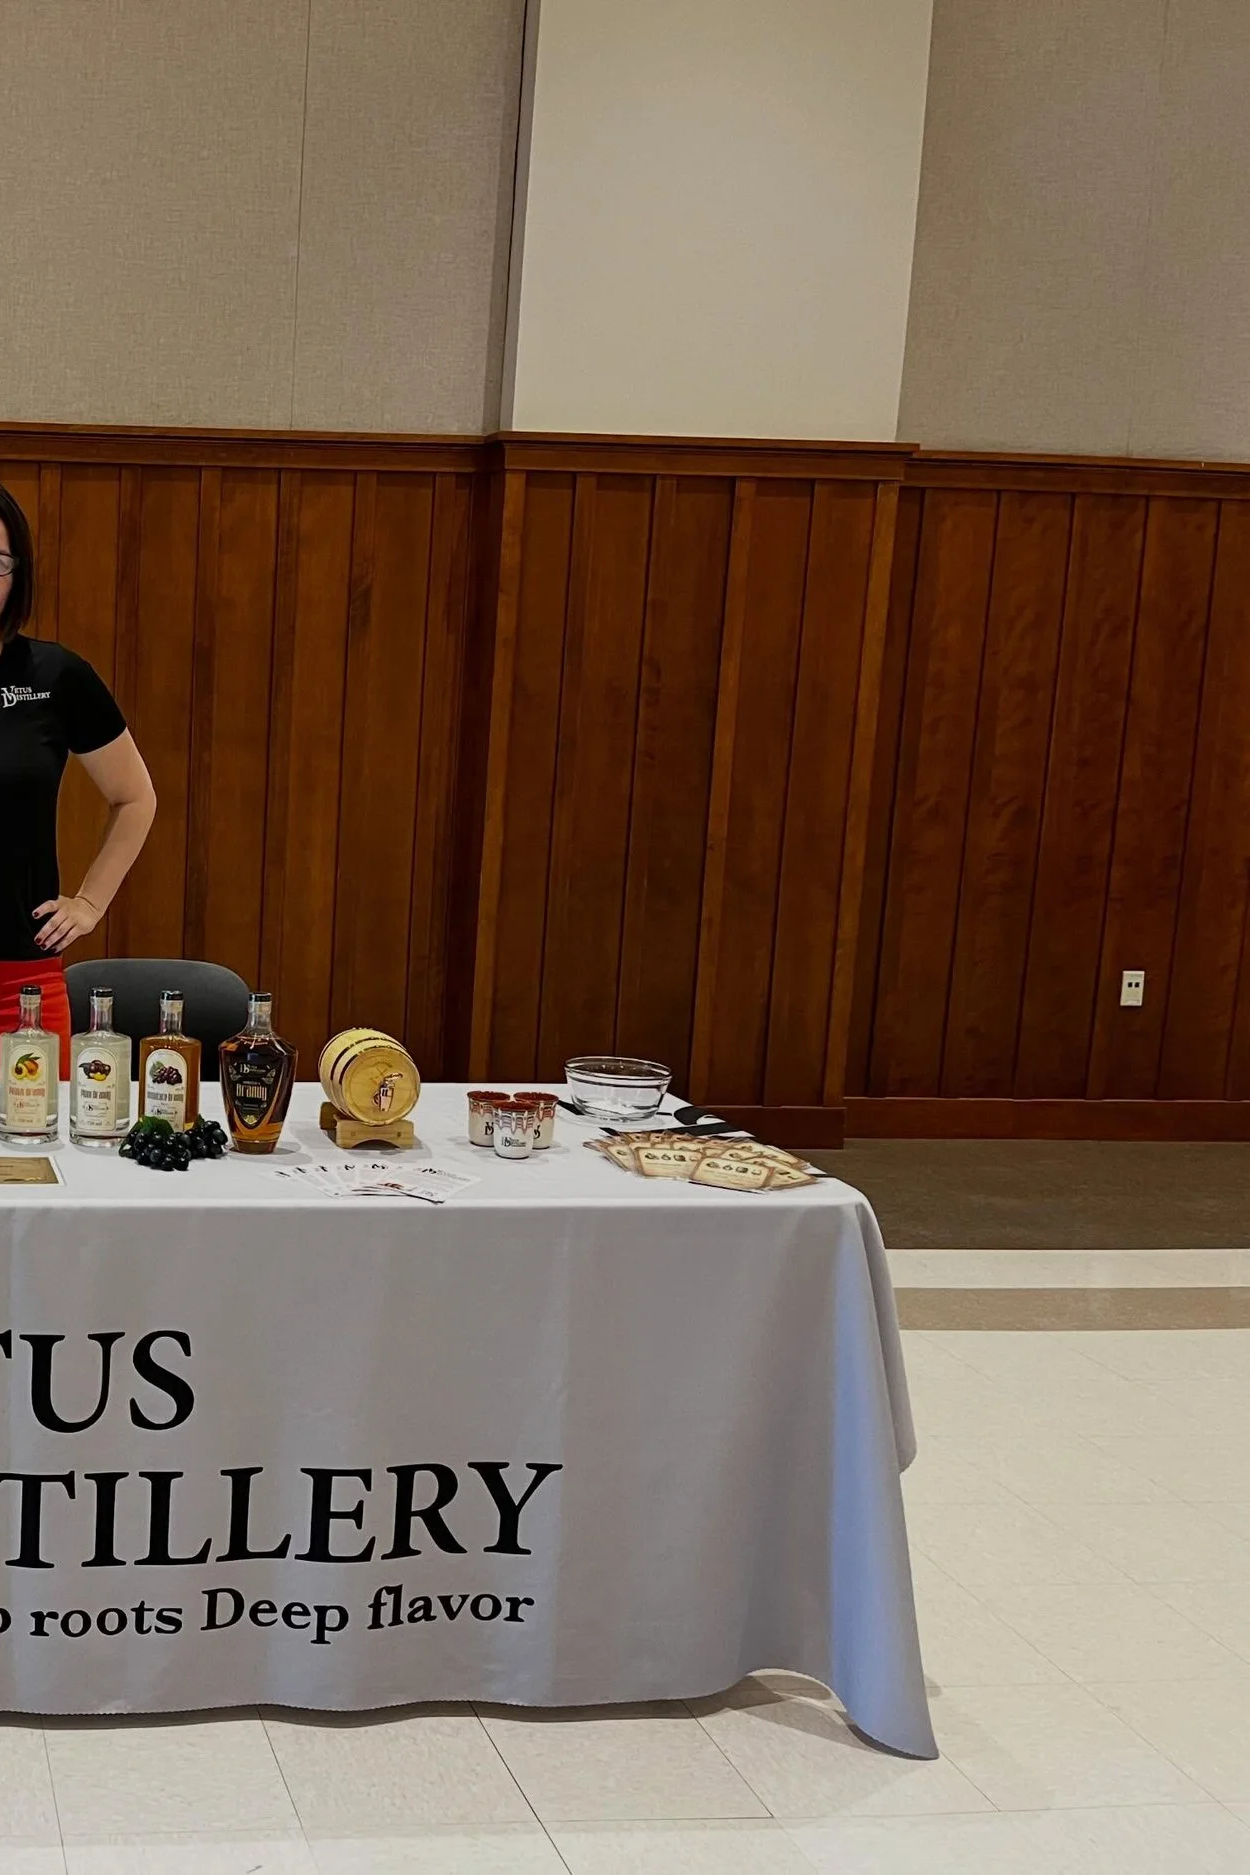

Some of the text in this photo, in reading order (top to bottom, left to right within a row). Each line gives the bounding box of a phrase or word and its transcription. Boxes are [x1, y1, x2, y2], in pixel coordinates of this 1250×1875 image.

[28, 1599, 184, 1638] roots
[200, 1586, 350, 1645] Deep
[366, 1583, 535, 1630] flavor
